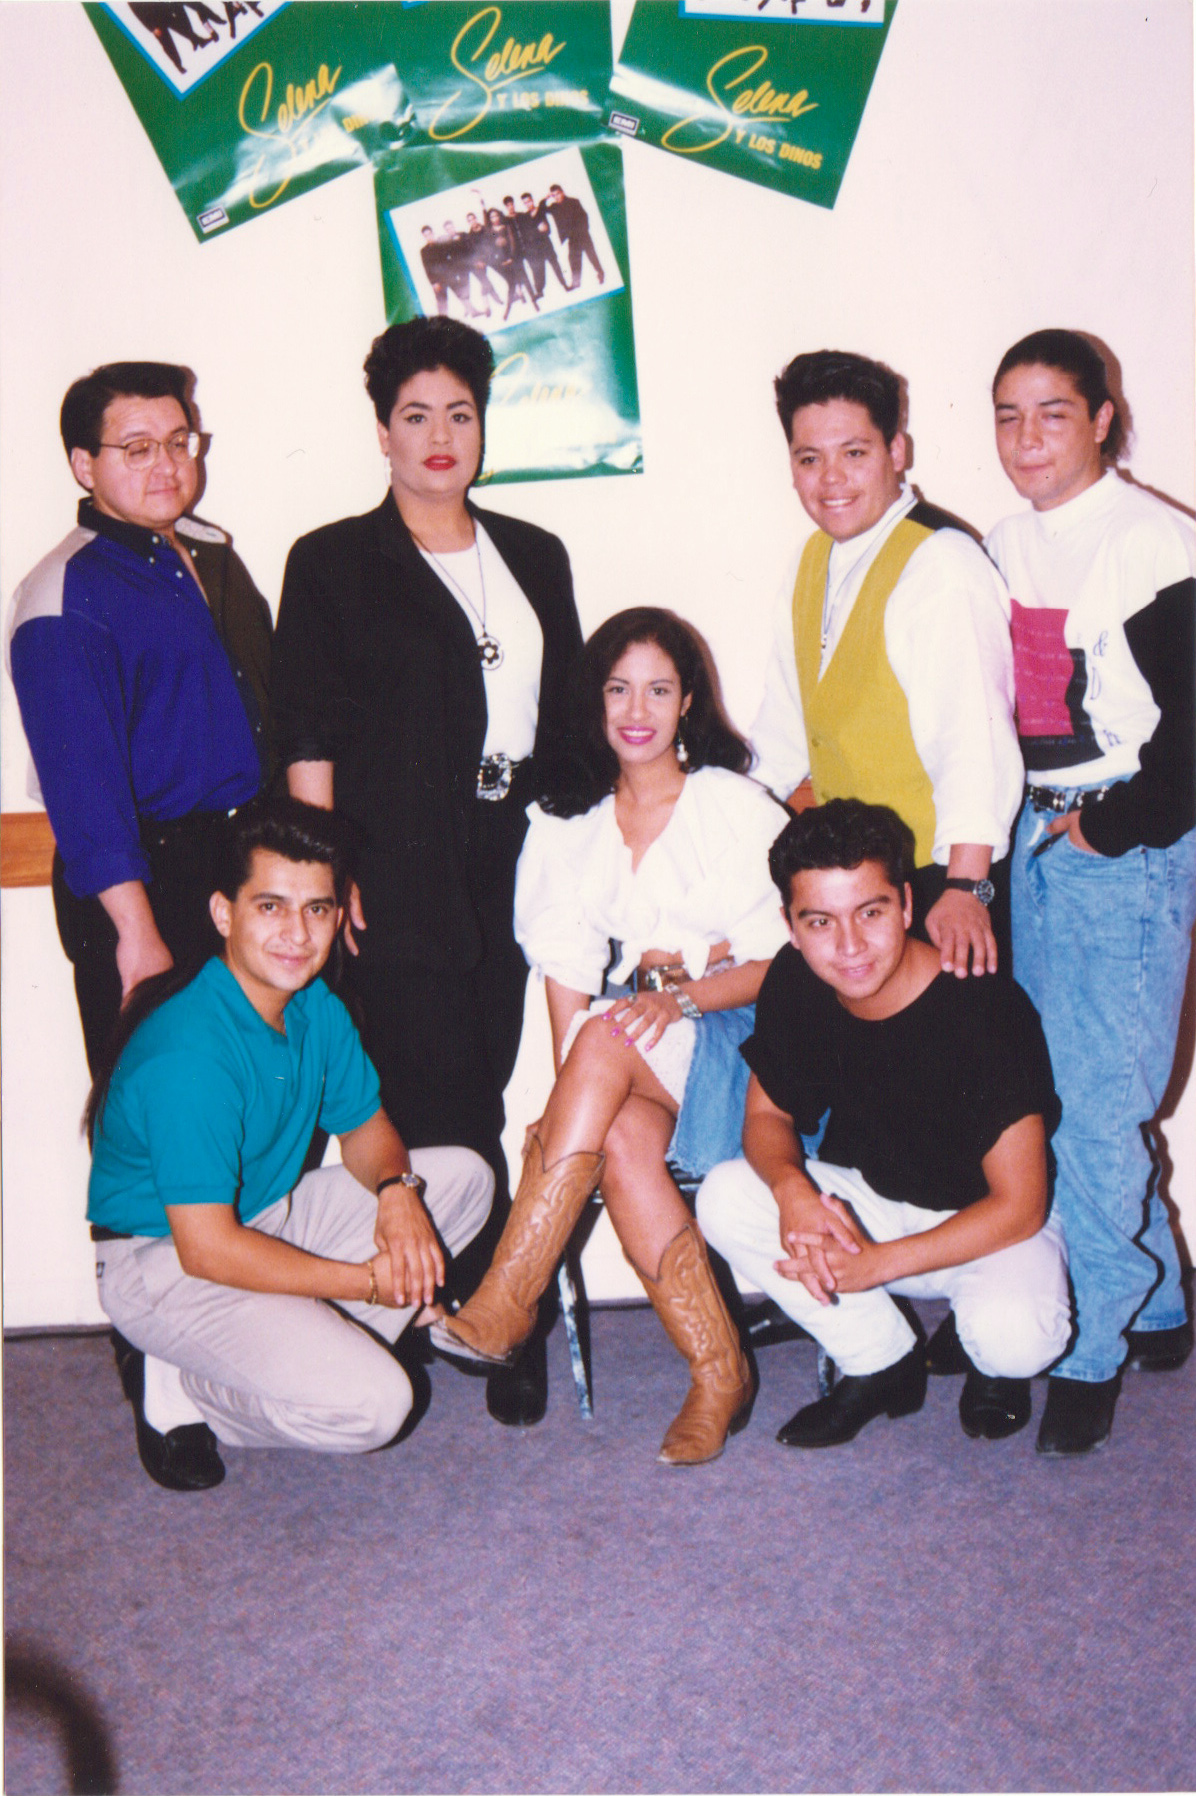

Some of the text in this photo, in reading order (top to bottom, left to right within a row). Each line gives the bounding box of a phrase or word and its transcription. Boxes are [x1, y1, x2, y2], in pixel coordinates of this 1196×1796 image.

[427, 6, 567, 141] Selena
[512, 91, 541, 111] LOS
[661, 44, 820, 153] Selena
[238, 62, 342, 208] Selena
[735, 128, 824, 170] Y LOS DINOS
